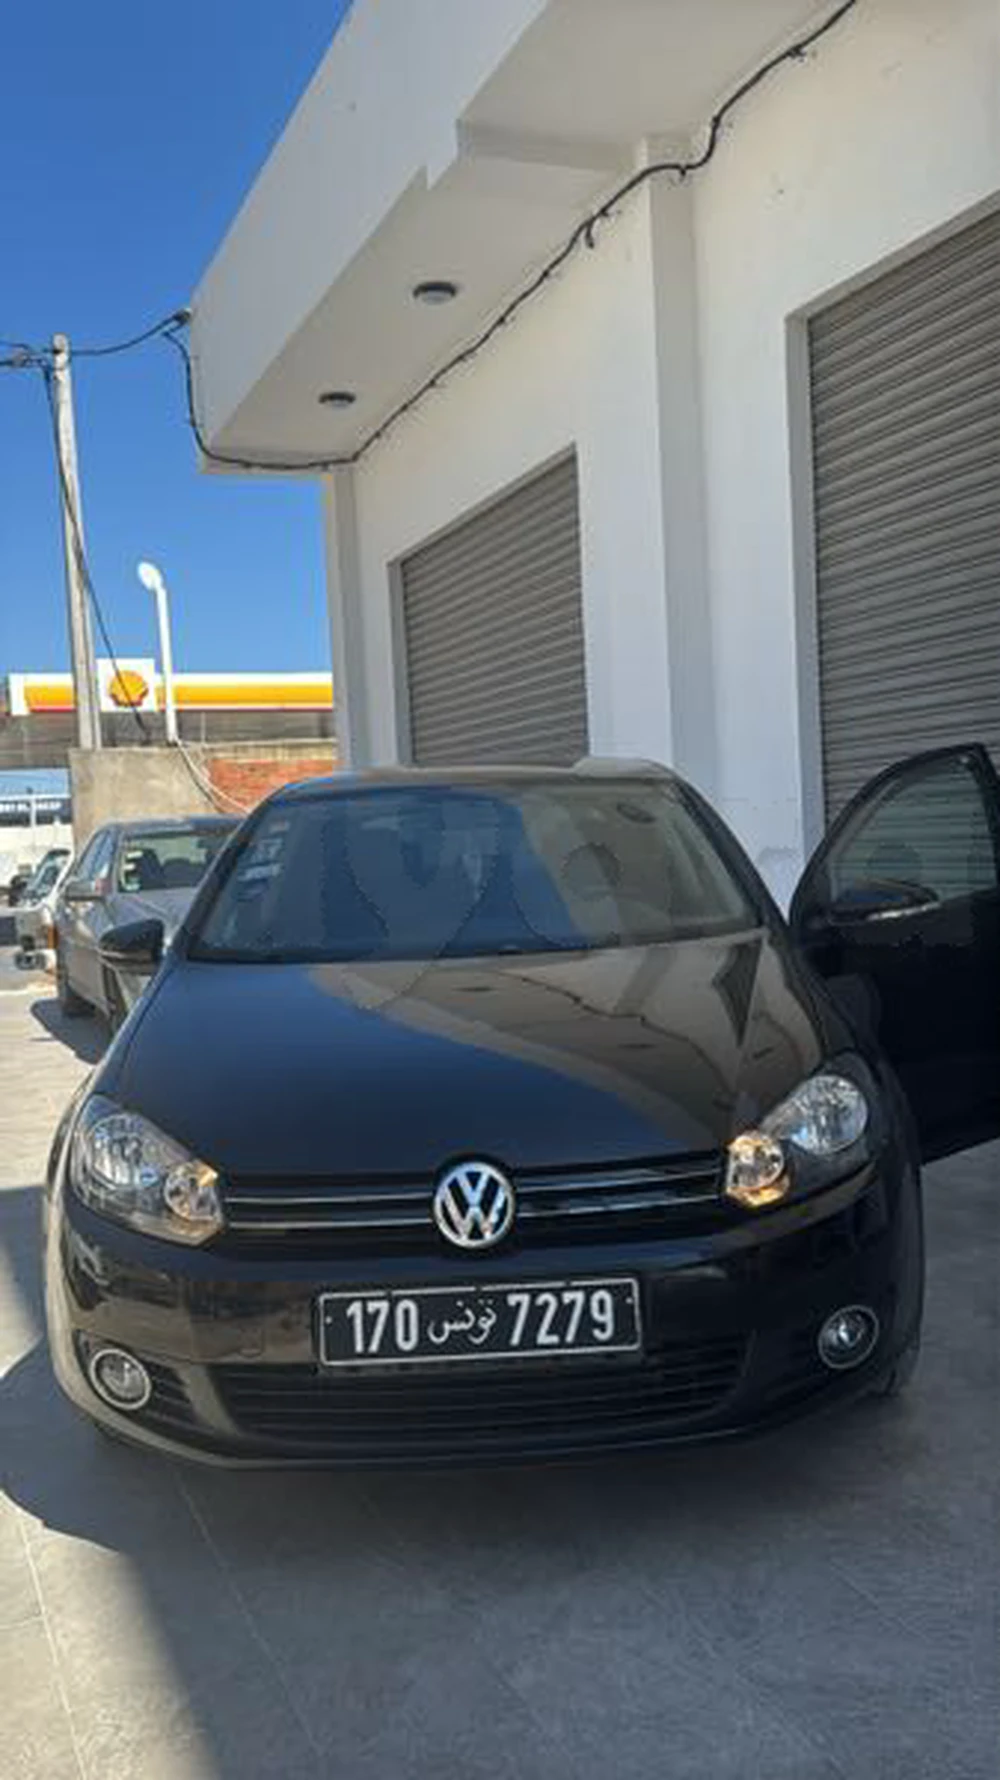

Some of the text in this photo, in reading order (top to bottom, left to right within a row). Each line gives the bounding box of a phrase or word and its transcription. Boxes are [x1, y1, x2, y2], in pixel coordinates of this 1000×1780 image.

[438, 1164, 511, 1246] VW
[346, 1289, 614, 1354] 170 تونس 7279
